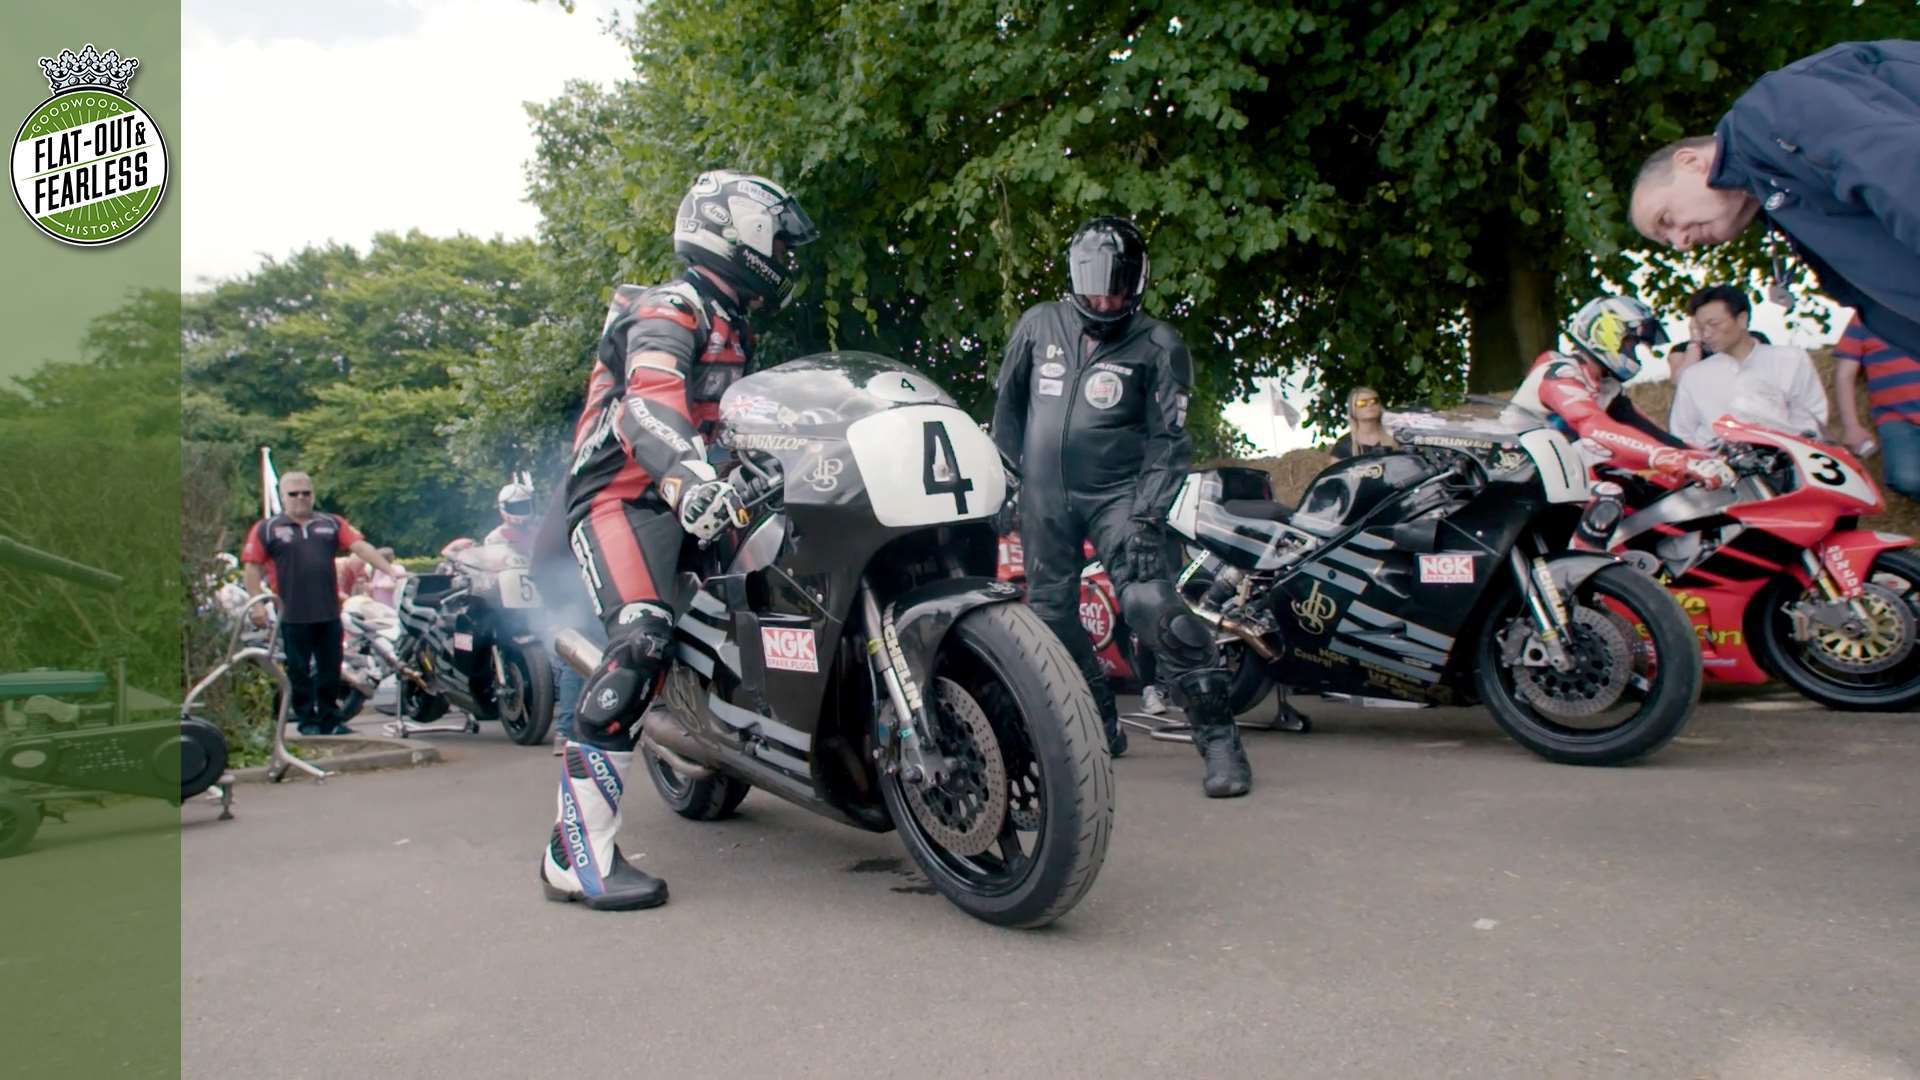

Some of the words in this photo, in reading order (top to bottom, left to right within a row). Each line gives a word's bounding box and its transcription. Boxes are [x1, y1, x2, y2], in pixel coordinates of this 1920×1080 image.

[901, 378, 916, 392] 4
[748, 435, 809, 450] DUNLOP
[1425, 436, 1493, 449] STRINGER
[923, 421, 974, 515] 4
[1809, 453, 1846, 486] 3
[1423, 557, 1471, 574] NGK
[520, 574, 534, 602] 5
[764, 630, 814, 660] NGK
[564, 792, 590, 868] daytona
